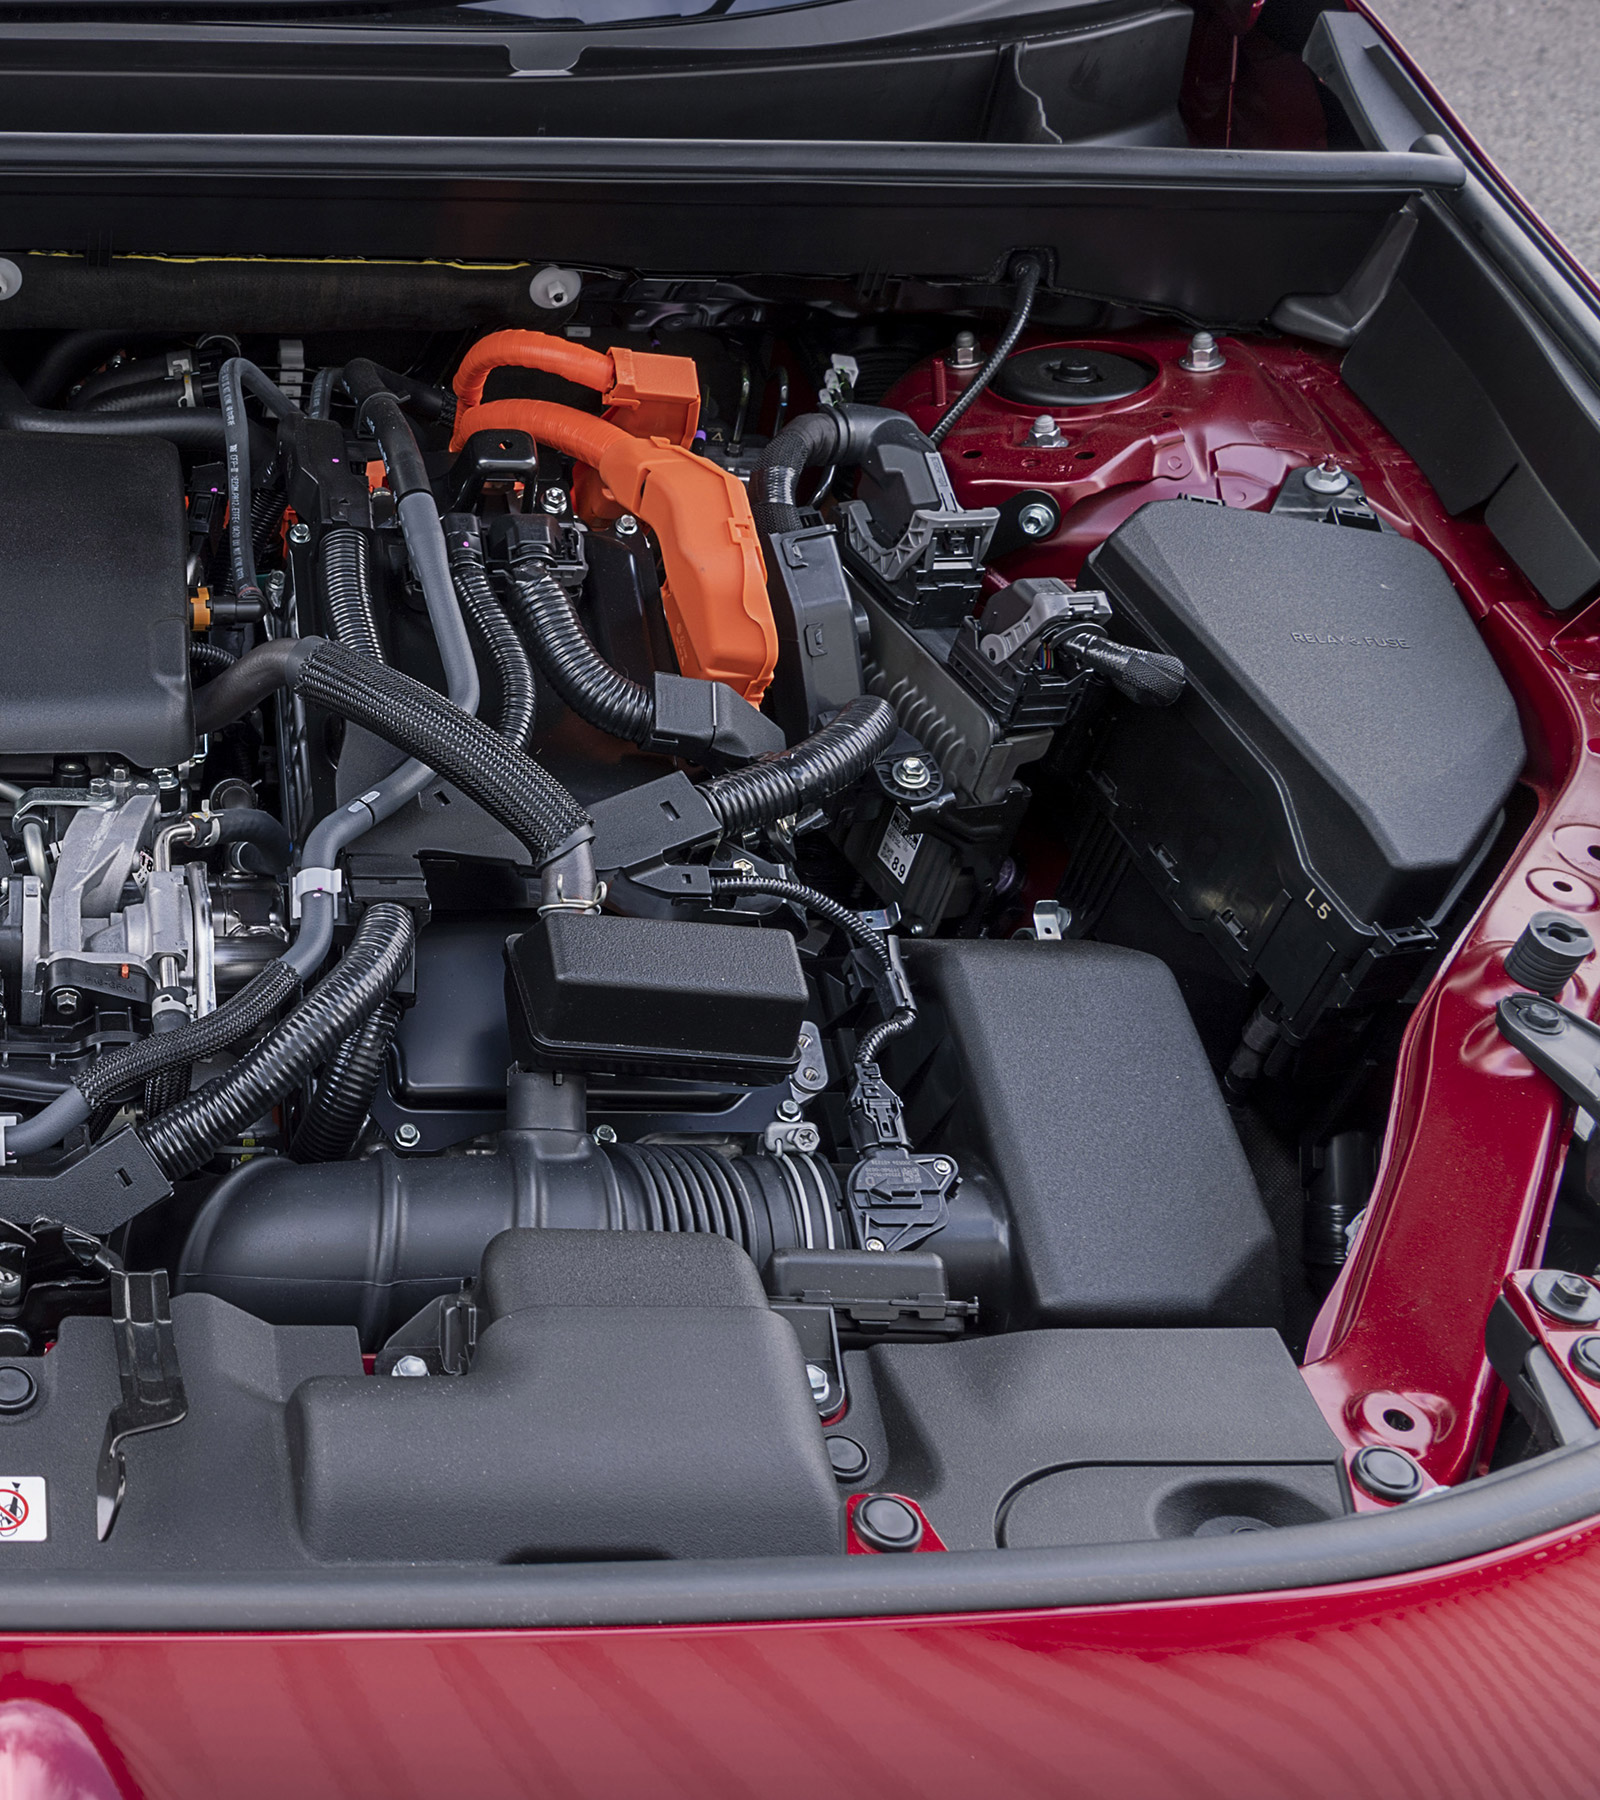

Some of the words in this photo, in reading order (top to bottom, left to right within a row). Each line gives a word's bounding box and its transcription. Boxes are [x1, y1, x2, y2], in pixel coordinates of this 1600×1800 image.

[1290, 632, 1344, 645] RELAY
[1349, 636, 1361, 646] &
[1363, 637, 1411, 650] FUSE
[891, 856, 906, 878] 89
[1305, 888, 1331, 919] L5
